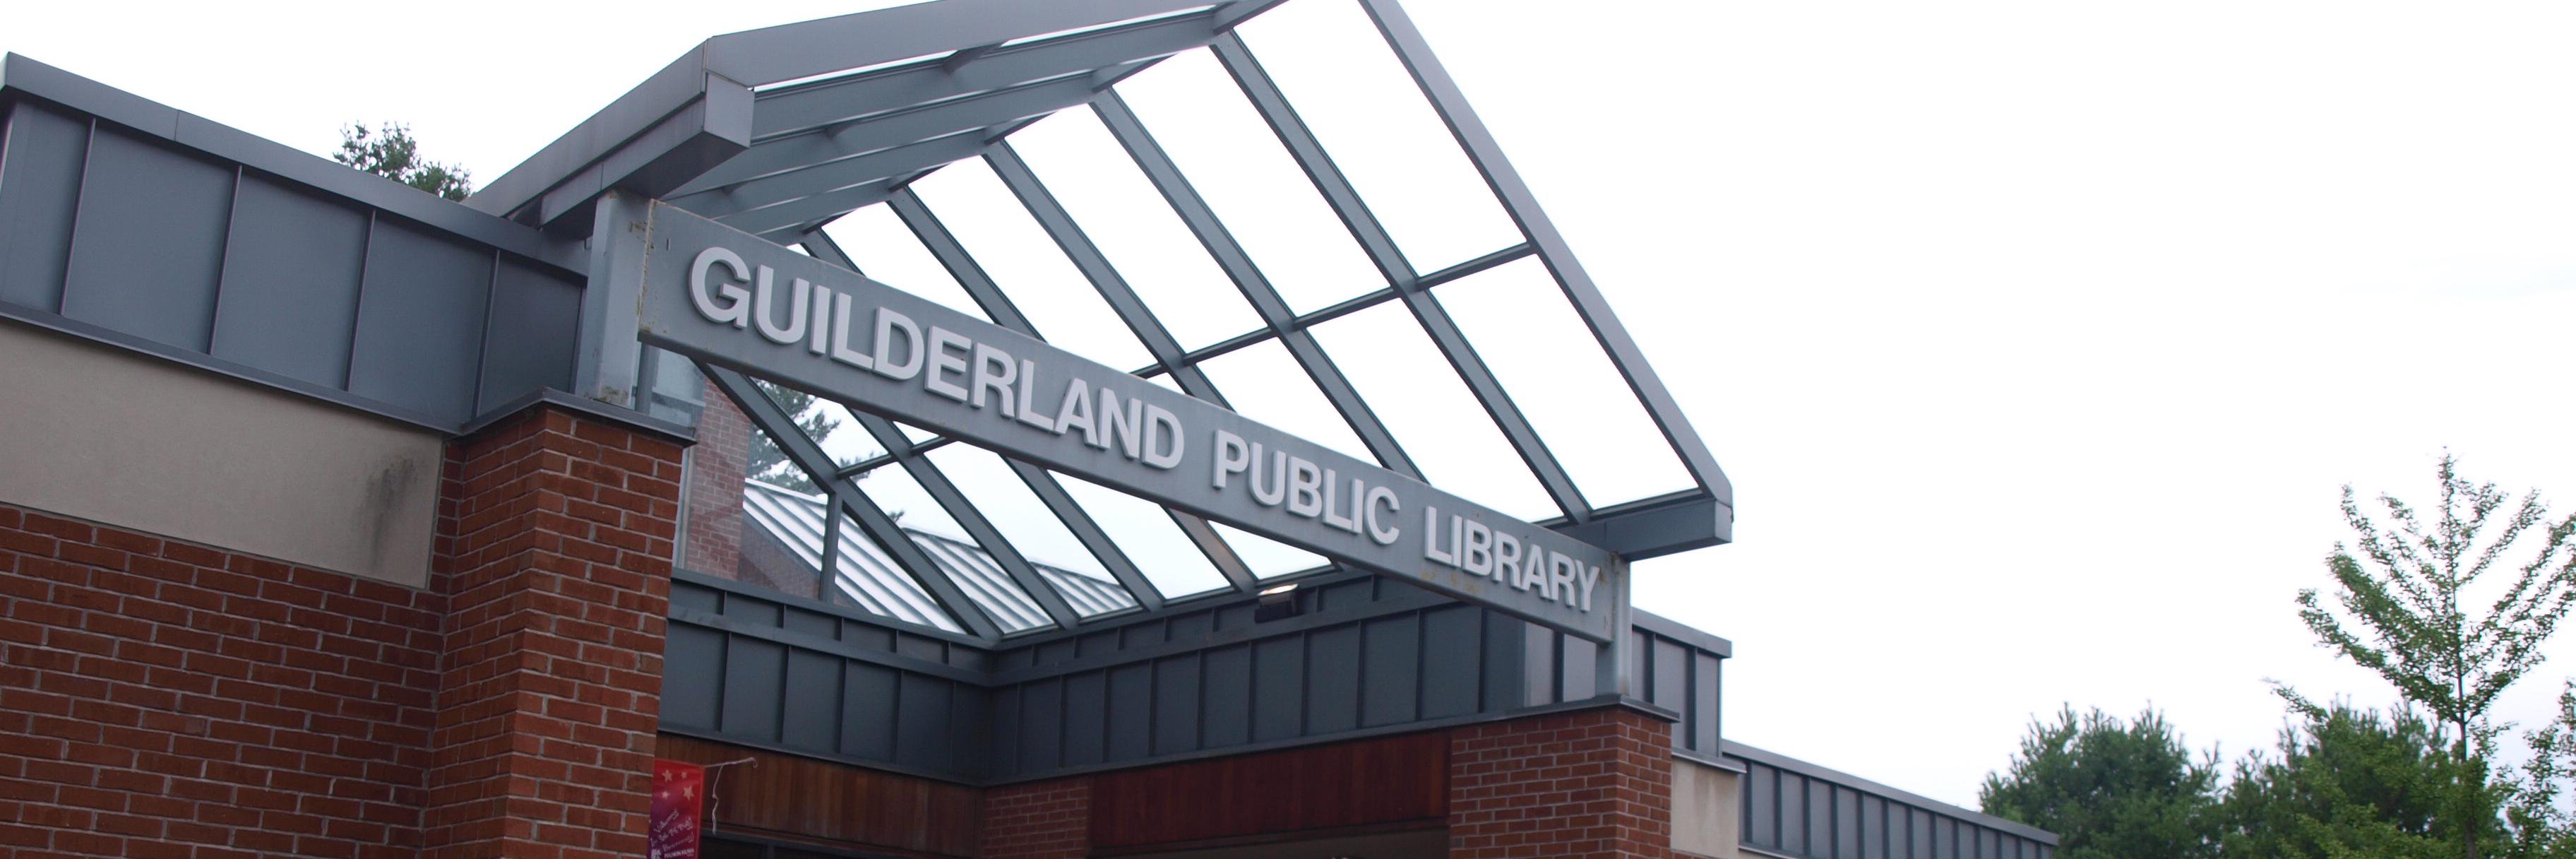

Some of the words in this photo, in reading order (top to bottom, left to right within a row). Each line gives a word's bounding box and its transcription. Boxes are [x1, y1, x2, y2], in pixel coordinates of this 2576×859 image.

[688, 247, 1185, 469] GUILDERLAND
[1212, 429, 1400, 545] PUBLIC
[1424, 506, 1599, 612] LIBRARY
